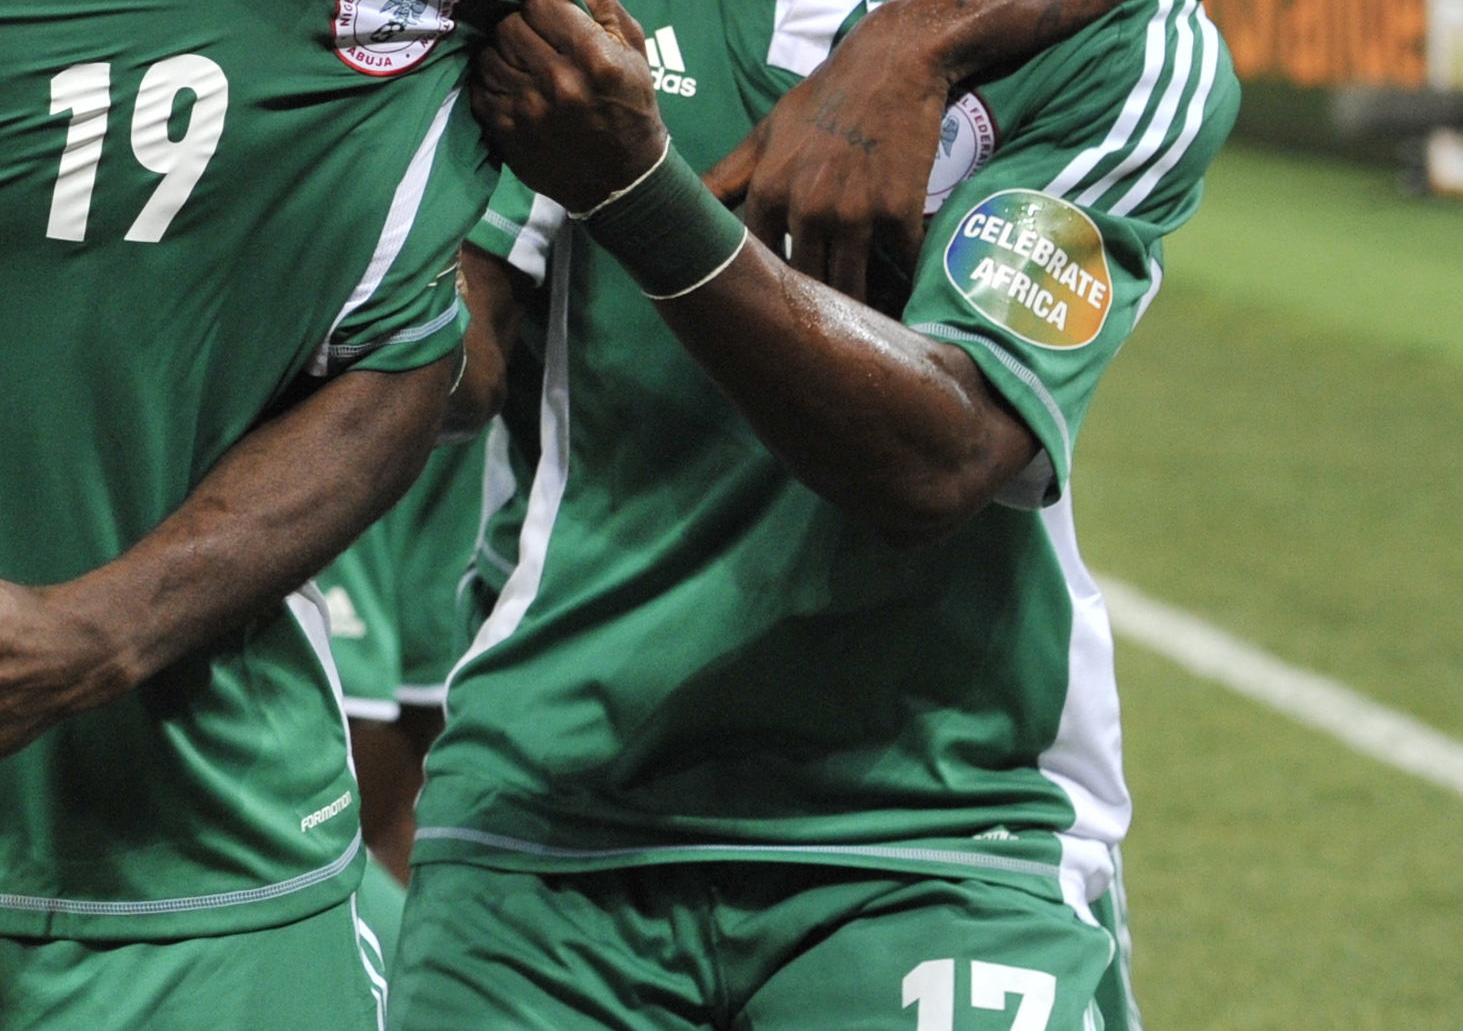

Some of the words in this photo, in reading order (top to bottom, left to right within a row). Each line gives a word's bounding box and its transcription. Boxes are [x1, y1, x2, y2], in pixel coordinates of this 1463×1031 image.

[347, 47, 392, 67] ABUJA
[650, 66, 697, 97] das
[47, 54, 228, 242] 19
[963, 213, 1107, 310] CELEBRATE
[969, 257, 1068, 332] AFRICA
